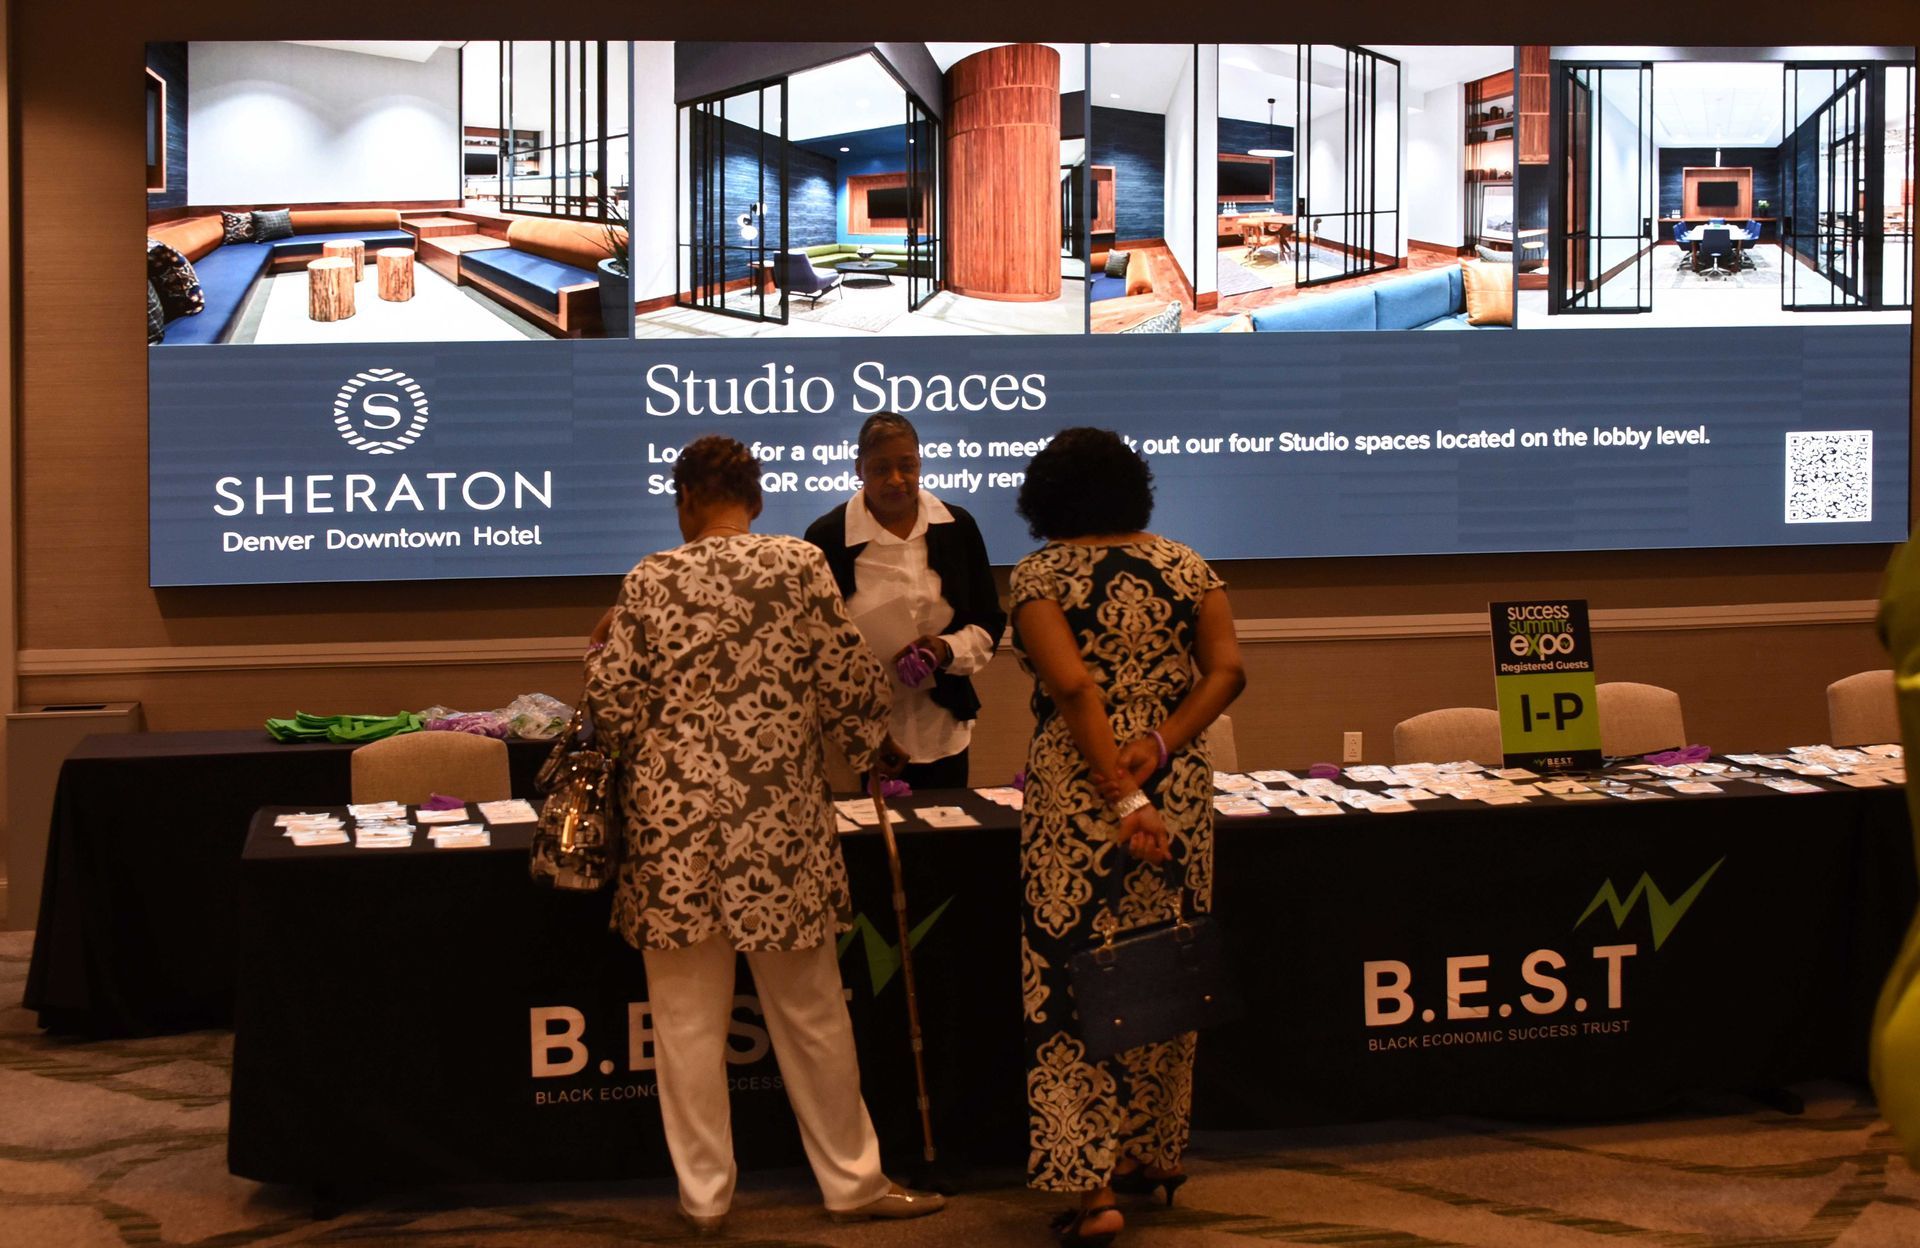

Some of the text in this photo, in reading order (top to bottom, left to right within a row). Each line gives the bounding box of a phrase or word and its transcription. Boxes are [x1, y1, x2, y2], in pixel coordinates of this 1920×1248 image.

[645, 361, 1047, 416] Studio Spaces
[362, 392, 401, 430] S
[750, 441, 785, 461] for
[791, 445, 806, 461] a
[812, 439, 860, 466] quic
[956, 438, 983, 458] to
[1142, 435, 1180, 455] out
[1185, 437, 1223, 454] our
[1229, 433, 1274, 453] four
[1279, 431, 1350, 452] Studio
[1354, 433, 1431, 455] spaces
[1436, 428, 1516, 450] located
[1520, 431, 1548, 448] on
[1552, 427, 1588, 447] the
[1593, 426, 1652, 450] lobby
[1656, 425, 1711, 445] level.
[213, 470, 552, 517] SHERATON
[760, 471, 799, 492] QR
[223, 525, 542, 553] Denver Downtown Hotel
[1510, 633, 1575, 661] expo
[1501, 661, 1589, 673] Registered Guests
[1520, 692, 1584, 733] I-P
[1363, 943, 1638, 1027] B.E.S.T
[1368, 1019, 1630, 1051] BLACK ECONOMIC SUCCESS TRUST
[536, 1088, 593, 1105] BLACK
[600, 1083, 660, 1101] ECONO
